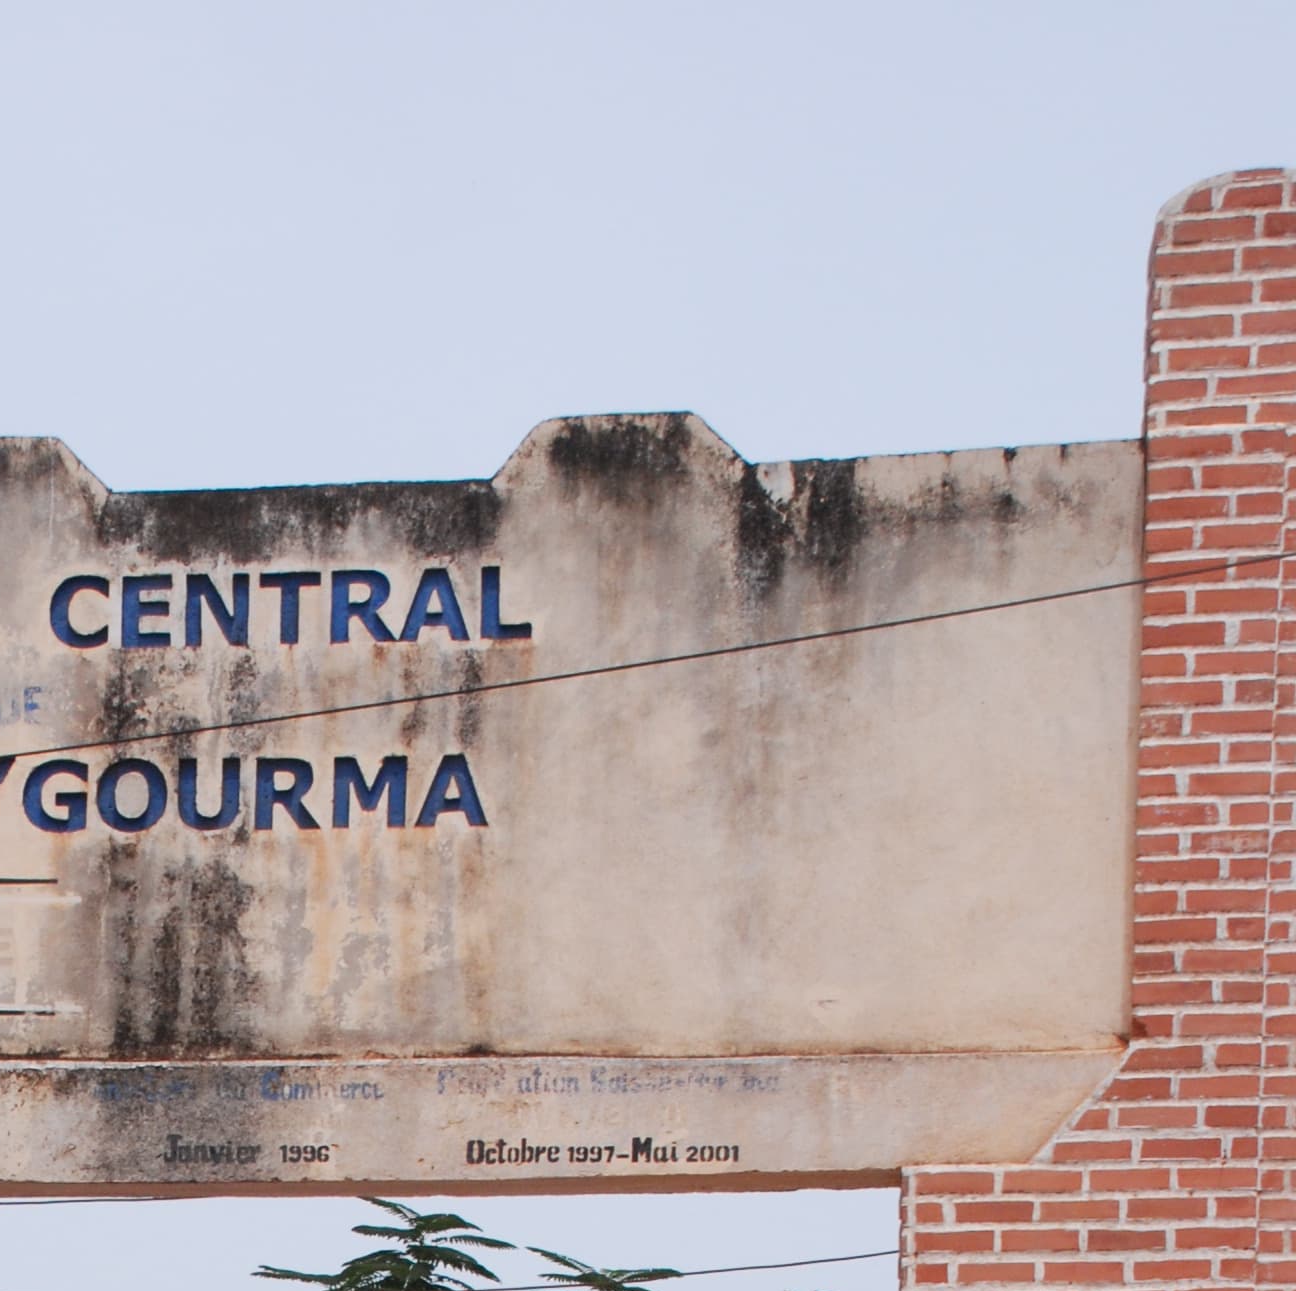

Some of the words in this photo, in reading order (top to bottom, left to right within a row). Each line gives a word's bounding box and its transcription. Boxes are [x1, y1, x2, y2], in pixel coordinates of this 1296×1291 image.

[49, 565, 534, 650] CENTRAL
[163, 1134, 261, 1164] Janvier
[279, 1144, 330, 1163] 1996
[466, 1138, 560, 1165] Octobre
[686, 1145, 740, 1163] 2001
